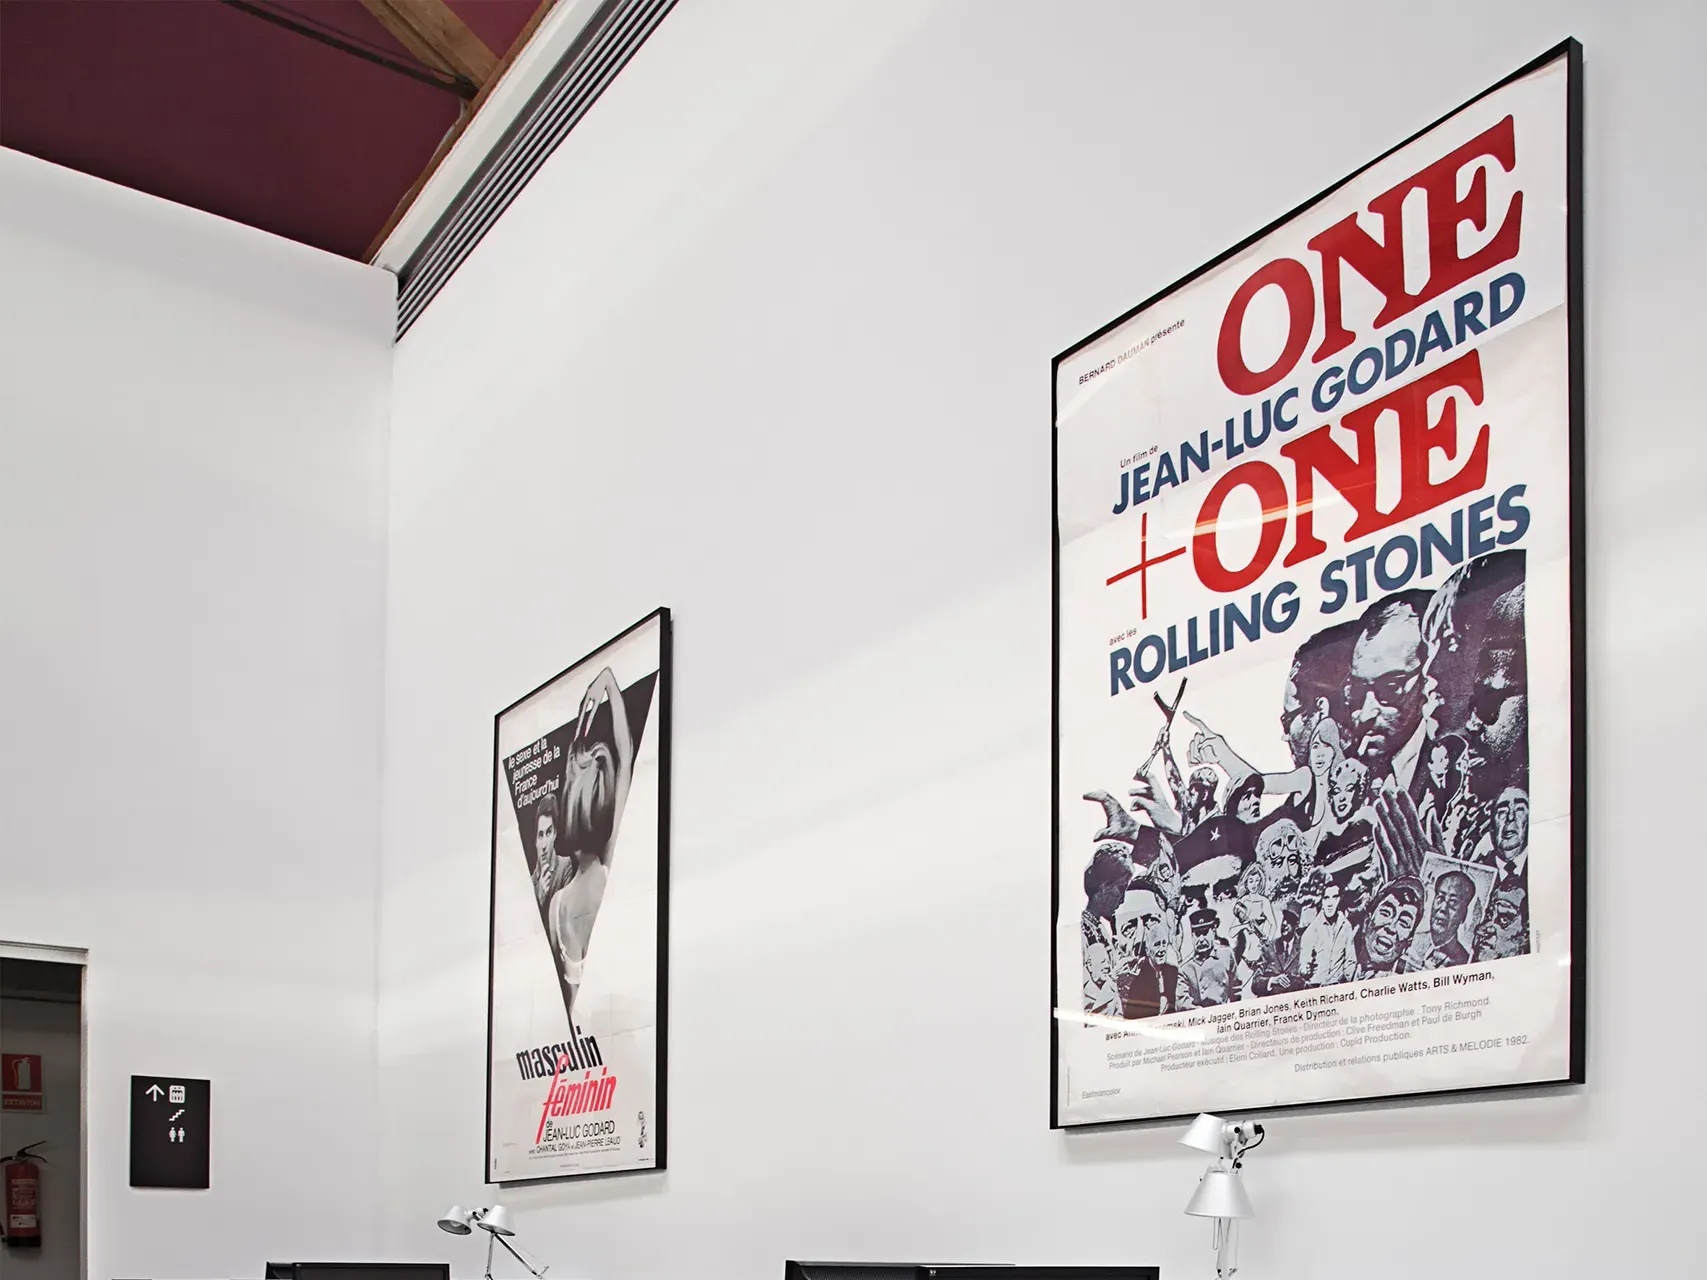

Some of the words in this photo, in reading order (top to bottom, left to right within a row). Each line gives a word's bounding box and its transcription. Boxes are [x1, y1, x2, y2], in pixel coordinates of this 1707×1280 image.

[1216, 114, 1523, 396] ONE
[1079, 359, 1116, 385] BERNARD
[1117, 338, 1150, 365] DAUMAN
[1150, 319, 1185, 344] présente
[1112, 387, 1300, 515] JEAN-LUC
[1311, 272, 1526, 413] GODARD
[1120, 459, 1131, 468] Un
[1132, 452, 1148, 463] film
[1149, 445, 1158, 455] de
[1192, 349, 1490, 594] ONE
[1110, 581, 1300, 697] ROLLING
[1319, 483, 1530, 614] STONES
[1109, 633, 1126, 646] avec
[1126, 627, 1137, 638] les
[508, 757, 515, 770] le
[516, 747, 532, 765] sexe
[533, 741, 540, 755] et
[541, 738, 547, 751] la
[512, 756, 542, 784] jeunesse
[542, 749, 553, 765] de
[553, 745, 560, 760] la
[515, 774, 537, 796] France
[517, 775, 559, 808] d'aujourd'hui
[1105, 1031, 1122, 1041] avec
[1188, 1015, 1206, 1027] Mick
[1208, 1011, 1237, 1024] Jagger,
[1239, 1006, 1261, 1019] Brian
[1263, 1002, 1291, 1014] Jones,
[1293, 996, 1318, 1010] Keith
[1320, 990, 1357, 1005] Richard,
[1360, 984, 1396, 999] Charlie
[1433, 975, 1450, 988] Bill
[1452, 971, 1495, 986] Wyman,
[1273, 1012, 1304, 1025] Franck
[1306, 1008, 1339, 1021] Dymon.
[1132, 1058, 1142, 1068] par
[1194, 1049, 1201, 1057] et
[1250, 1037, 1289, 1049] Directeurs
[1290, 1034, 1300, 1043] de
[1301, 1029, 1340, 1044] production
[1346, 1025, 1366, 1036] Clive
[1367, 1020, 1410, 1032] Freedman
[1411, 1017, 1420, 1026] et
[1421, 1015, 1441, 1025] Paul
[1442, 1012, 1453, 1022] de
[1455, 1009, 1482, 1021] Burgh
[1134, 1049, 1142, 1057] de
[1230, 1032, 1244, 1041] des
[1272, 1025, 1298, 1036] Stones
[1303, 1019, 1338, 1031] Directeur
[1339, 1017, 1348, 1026] de
[1350, 1015, 1357, 1023] la
[1359, 1008, 1415, 1023] photographie
[1421, 1003, 1443, 1014] Tony
[1444, 996, 1491, 1011] Richmond.
[516, 1025, 604, 1081] masculin
[1160, 1060, 1196, 1072] Producteur
[1279, 1047, 1294, 1056] Une
[1295, 1040, 1335, 1056] production
[1340, 1036, 1363, 1048] Cupid
[1364, 1031, 1412, 1044] Production.
[1294, 1060, 1337, 1073] Distribution
[1338, 1058, 1346, 1066] et
[1347, 1053, 1381, 1065] relations
[1383, 1049, 1423, 1064] publiques
[1426, 1044, 1450, 1055] ARTS
[1450, 1043, 1458, 1053] &
[535, 1054, 617, 1145] féminin
[1081, 1087, 1121, 1099] Eastmancolor
[536, 1143, 557, 1153] CHANTAL
[543, 1124, 581, 1142] JEAN-LUC
[582, 1120, 615, 1138] GODARD
